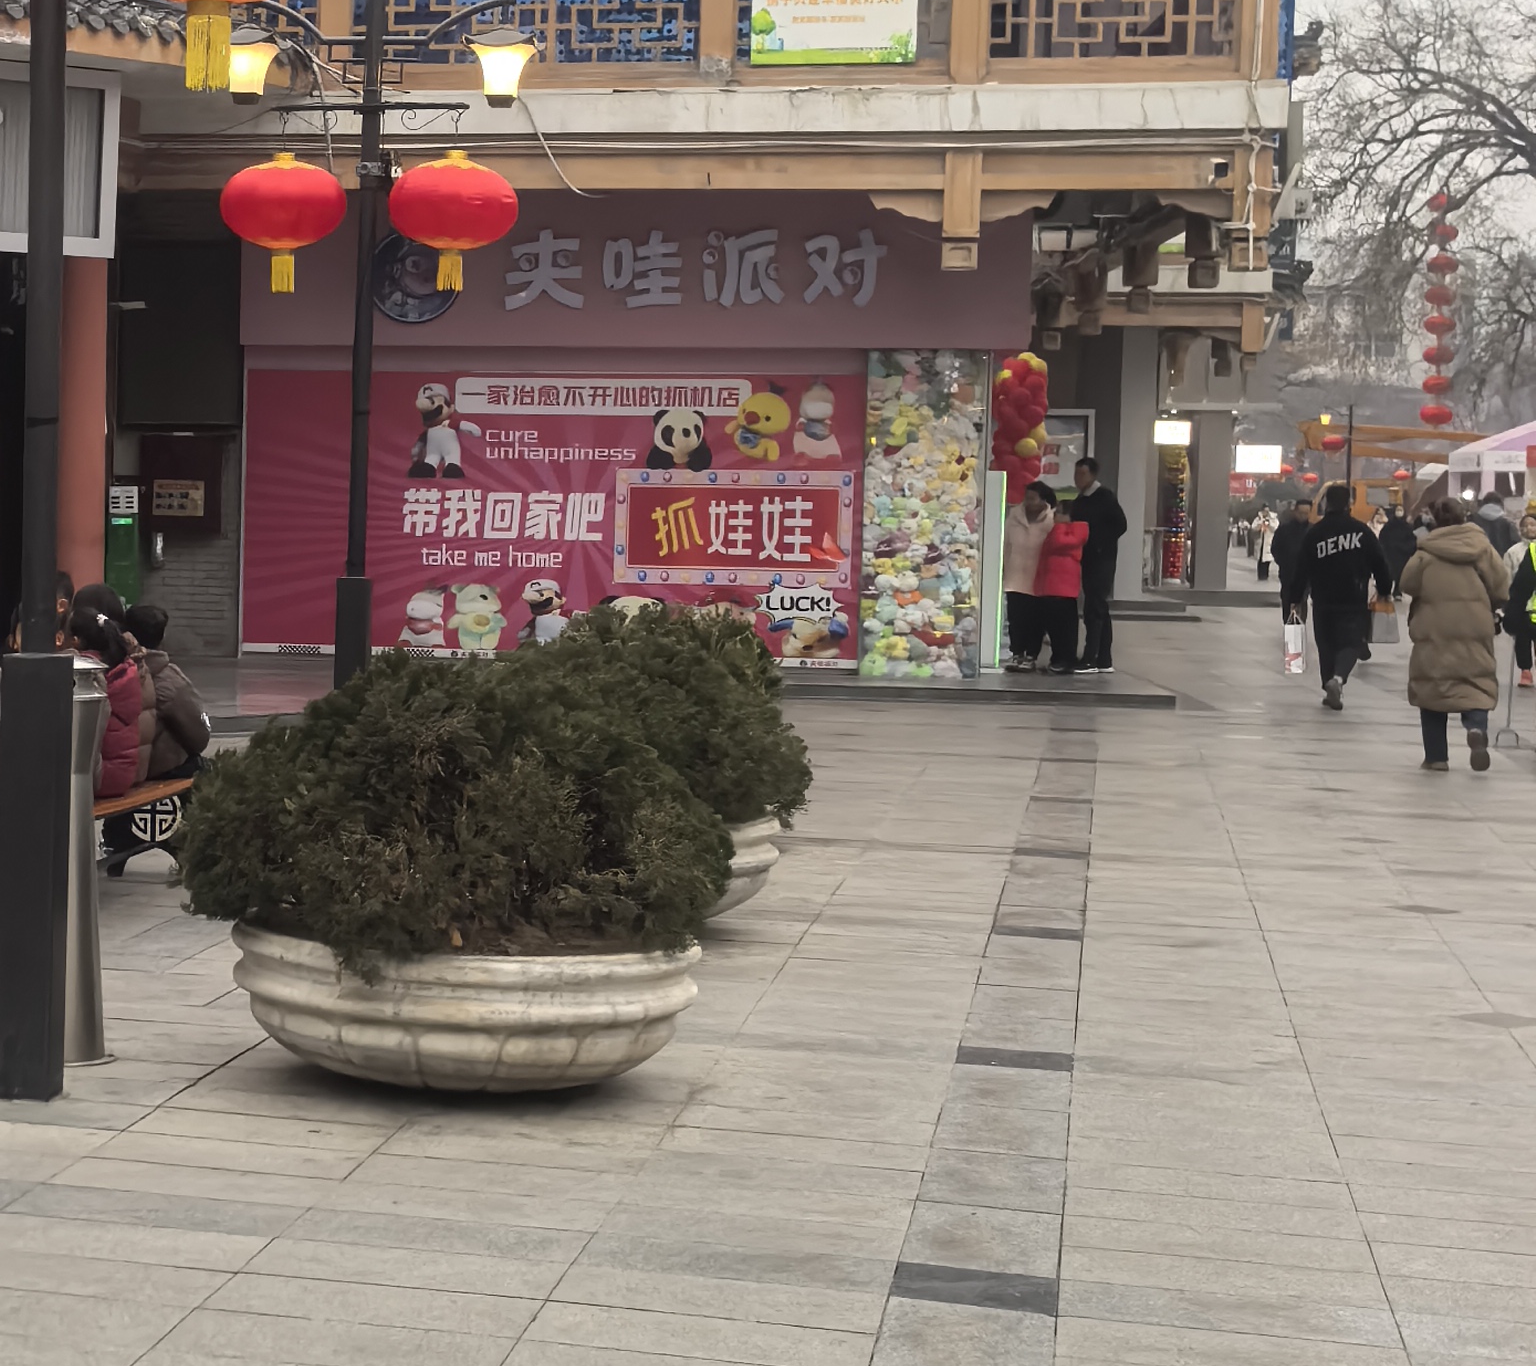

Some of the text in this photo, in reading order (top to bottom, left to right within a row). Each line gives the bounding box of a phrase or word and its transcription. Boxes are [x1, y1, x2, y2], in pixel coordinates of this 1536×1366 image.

[504, 228, 888, 311] 夹哇派对
[461, 384, 740, 409] 一家治愈不开心的抓机店
[485, 443, 636, 463] unhappiness
[402, 488, 606, 542] 带我回家吧
[651, 496, 814, 563] 抓娃娃
[420, 545, 563, 568] take me home
[1316, 531, 1364, 559] DENK
[765, 595, 832, 612] LUCK!
